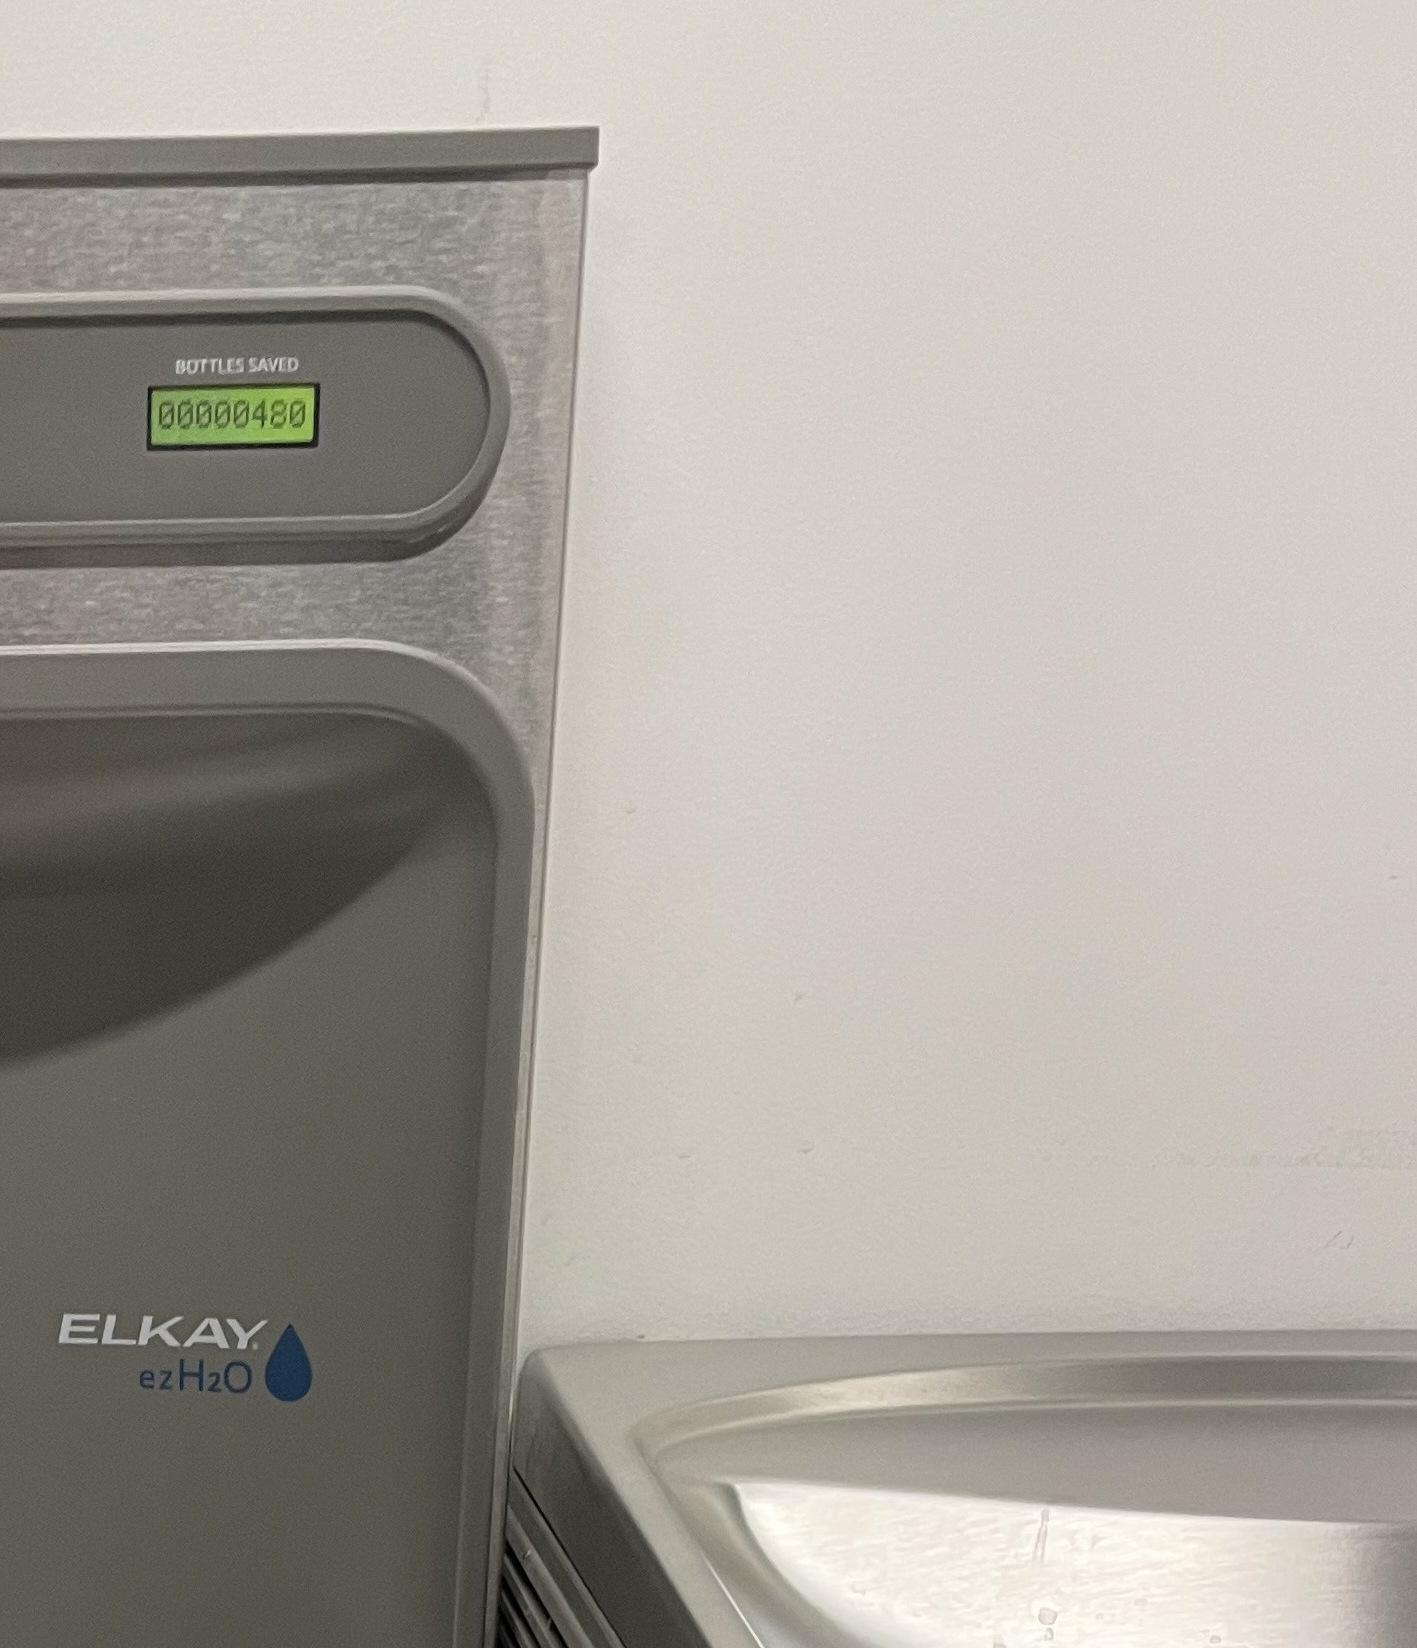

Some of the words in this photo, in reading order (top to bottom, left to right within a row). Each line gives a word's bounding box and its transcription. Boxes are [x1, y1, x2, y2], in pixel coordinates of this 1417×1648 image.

[174, 357, 245, 375] BOTTLES
[248, 356, 299, 373] SAVED
[158, 399, 306, 430] 00000480
